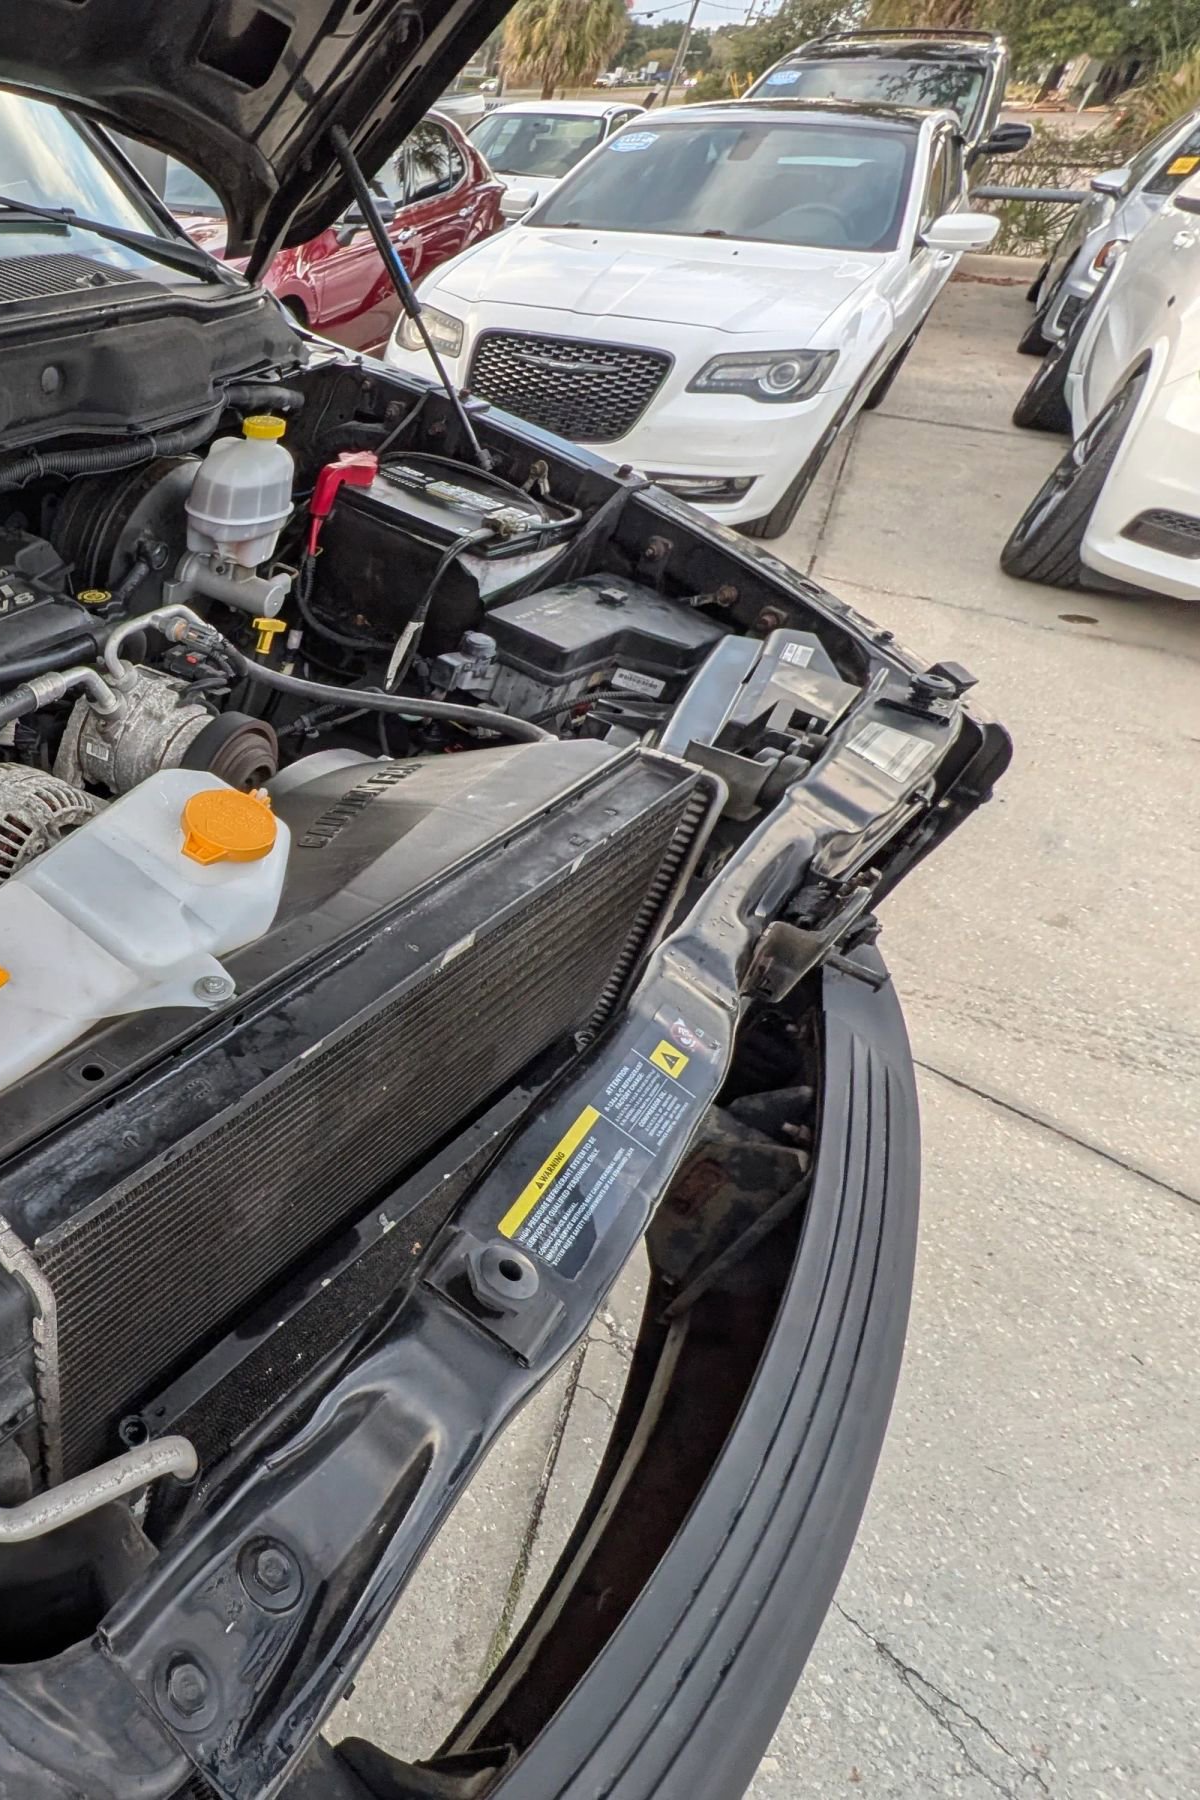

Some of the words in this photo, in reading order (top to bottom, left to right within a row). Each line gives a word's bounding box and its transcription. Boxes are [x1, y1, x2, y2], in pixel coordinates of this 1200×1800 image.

[297, 785, 388, 849] CAUTION
[604, 1064, 629, 1095] ATTENTION
[615, 1089, 632, 1109] FACTORY
[540, 1150, 565, 1183] WARNING
[545, 1167, 573, 1203] REFRIGERANT
[569, 1148, 587, 1170] SYSTEM
[582, 1141, 592, 1151] TO
[587, 1135, 596, 1144] BE
[526, 1221, 547, 1248] SERVICED
[543, 1214, 552, 1224] BY
[548, 1188, 570, 1217] QUALIFIED
[566, 1160, 590, 1191] PERSONNEL
[584, 1192, 594, 1204] MAY
[572, 1219, 585, 1236] SAFETY
